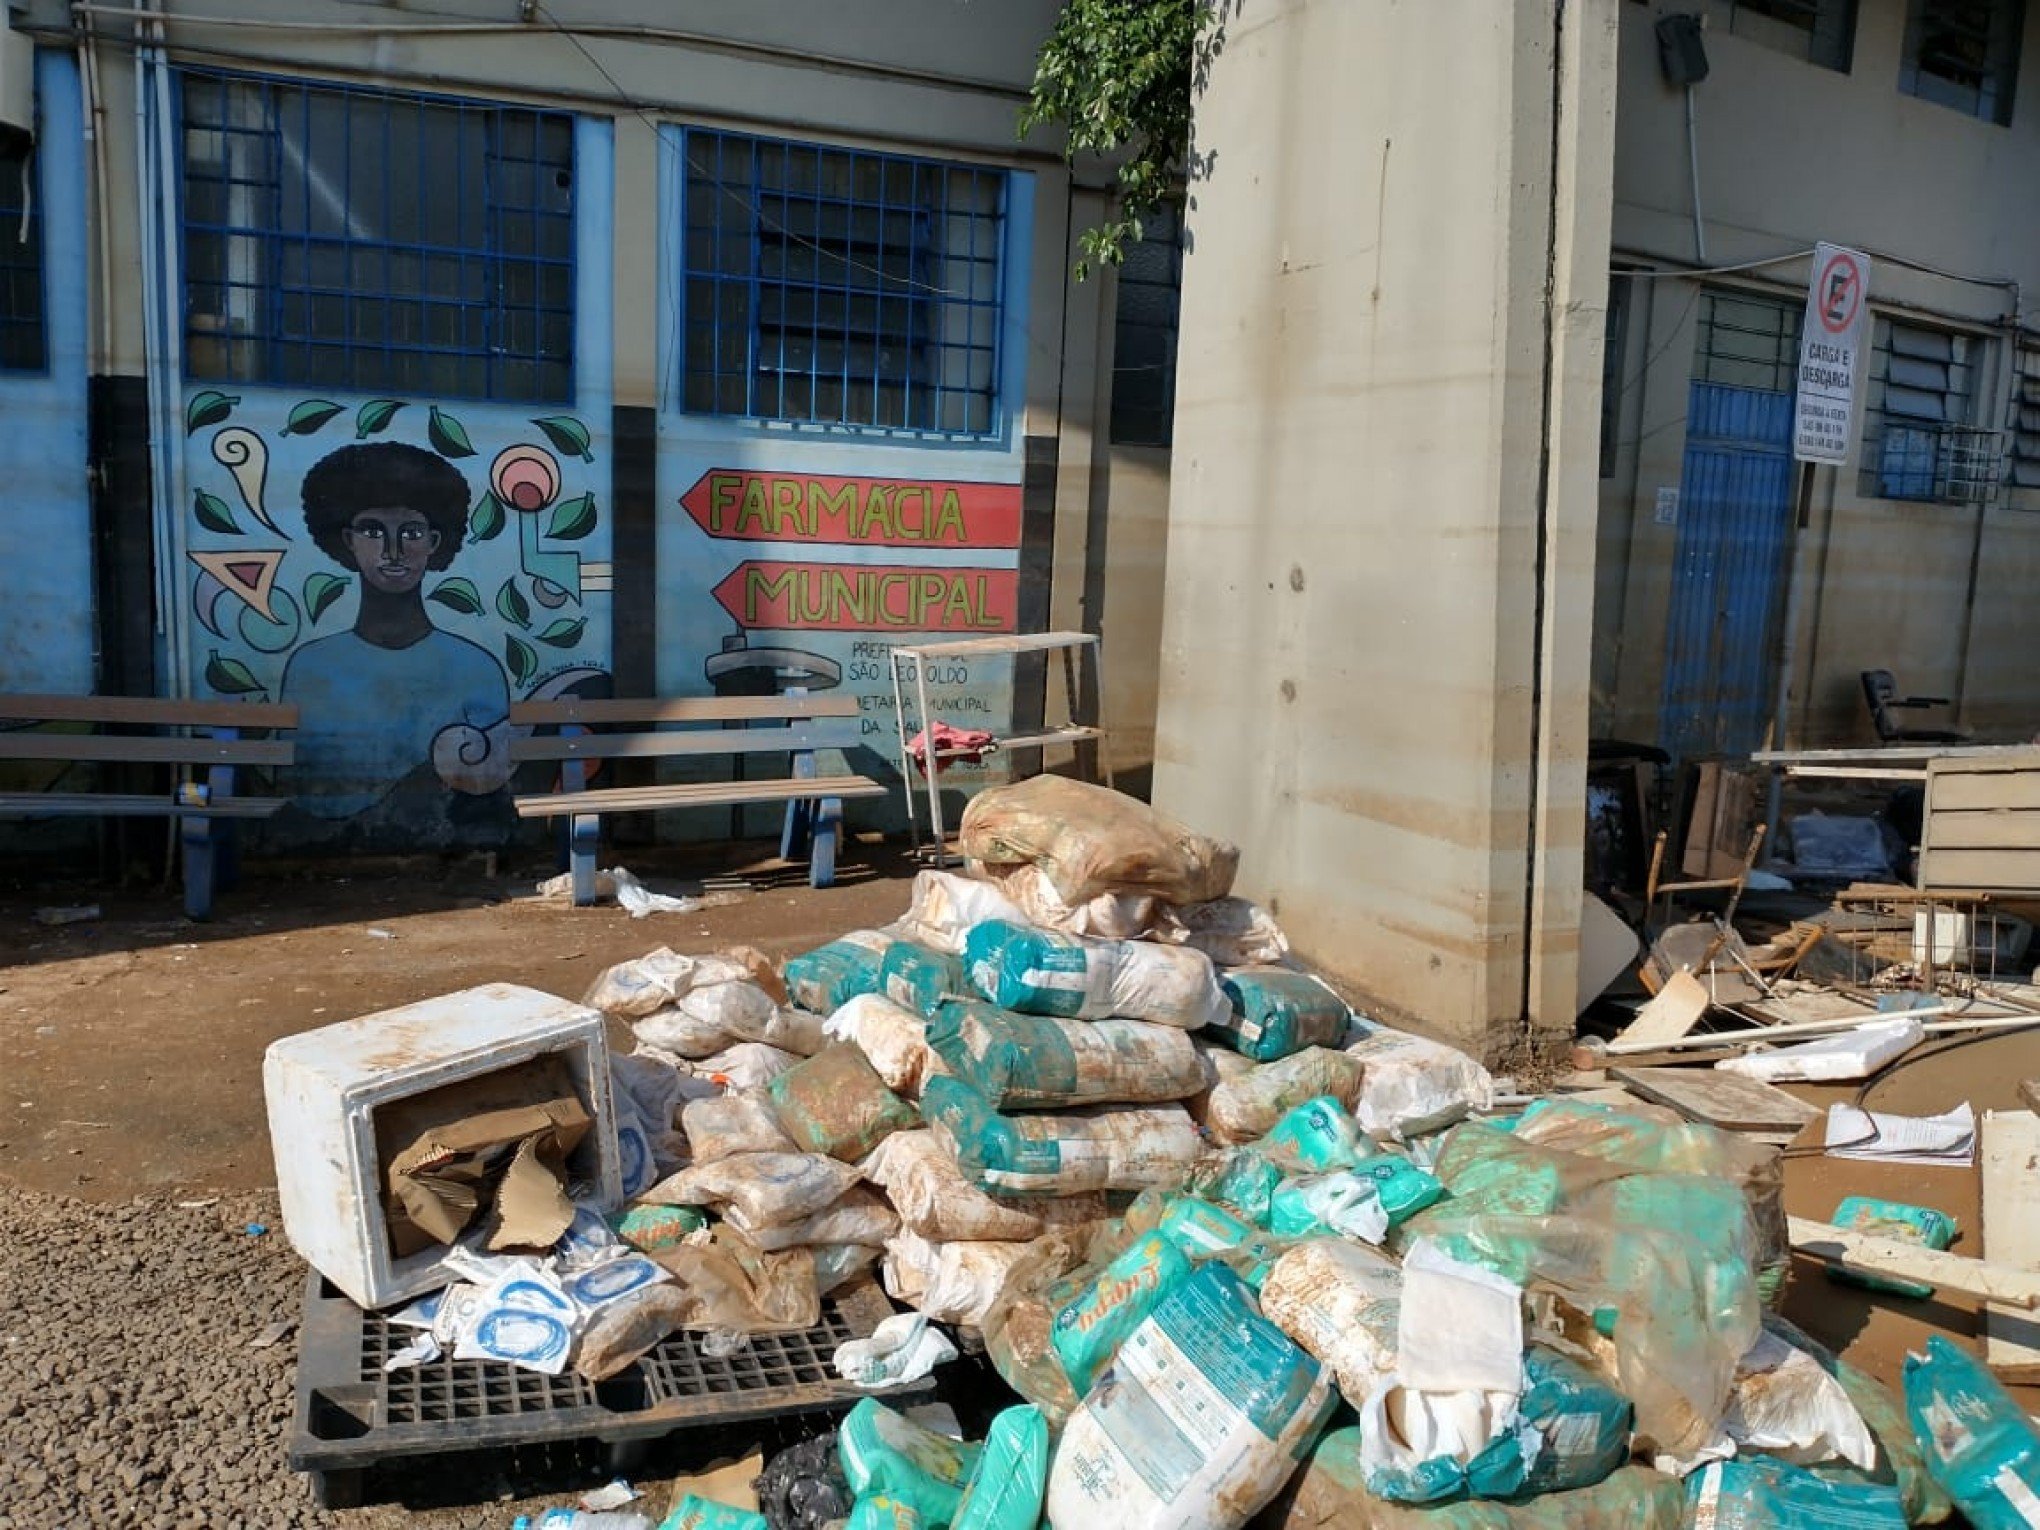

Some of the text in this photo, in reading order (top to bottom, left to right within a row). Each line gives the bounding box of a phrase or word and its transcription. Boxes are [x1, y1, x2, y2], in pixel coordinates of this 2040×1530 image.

[1809, 343, 1849, 366] CARGA E
[710, 476, 966, 541] FARMÁCIA
[746, 568, 1001, 626] MUNICIPAL
[849, 661, 968, 684] SÃO LEOOLDO
[862, 718, 881, 735] DA
